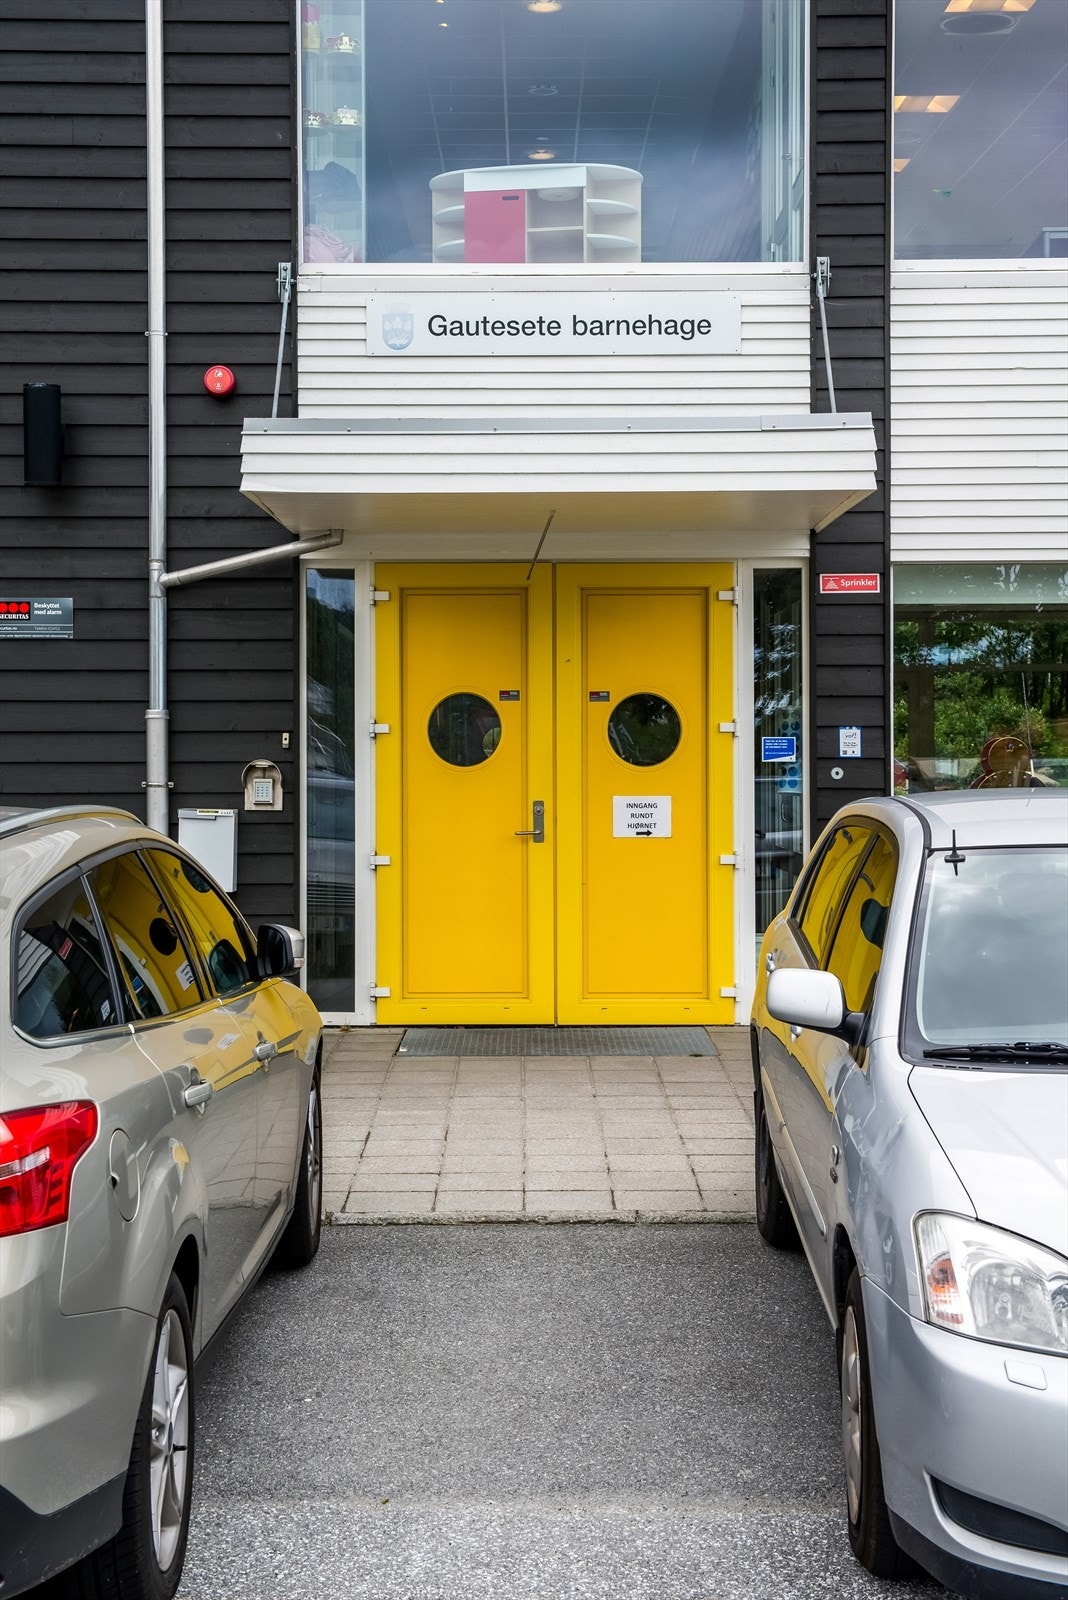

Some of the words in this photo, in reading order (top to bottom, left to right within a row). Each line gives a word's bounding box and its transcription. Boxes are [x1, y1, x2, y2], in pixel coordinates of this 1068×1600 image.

[427, 314, 562, 337] Gautesete
[572, 314, 712, 341] barnehage
[840, 579, 876, 588] Sprinkler
